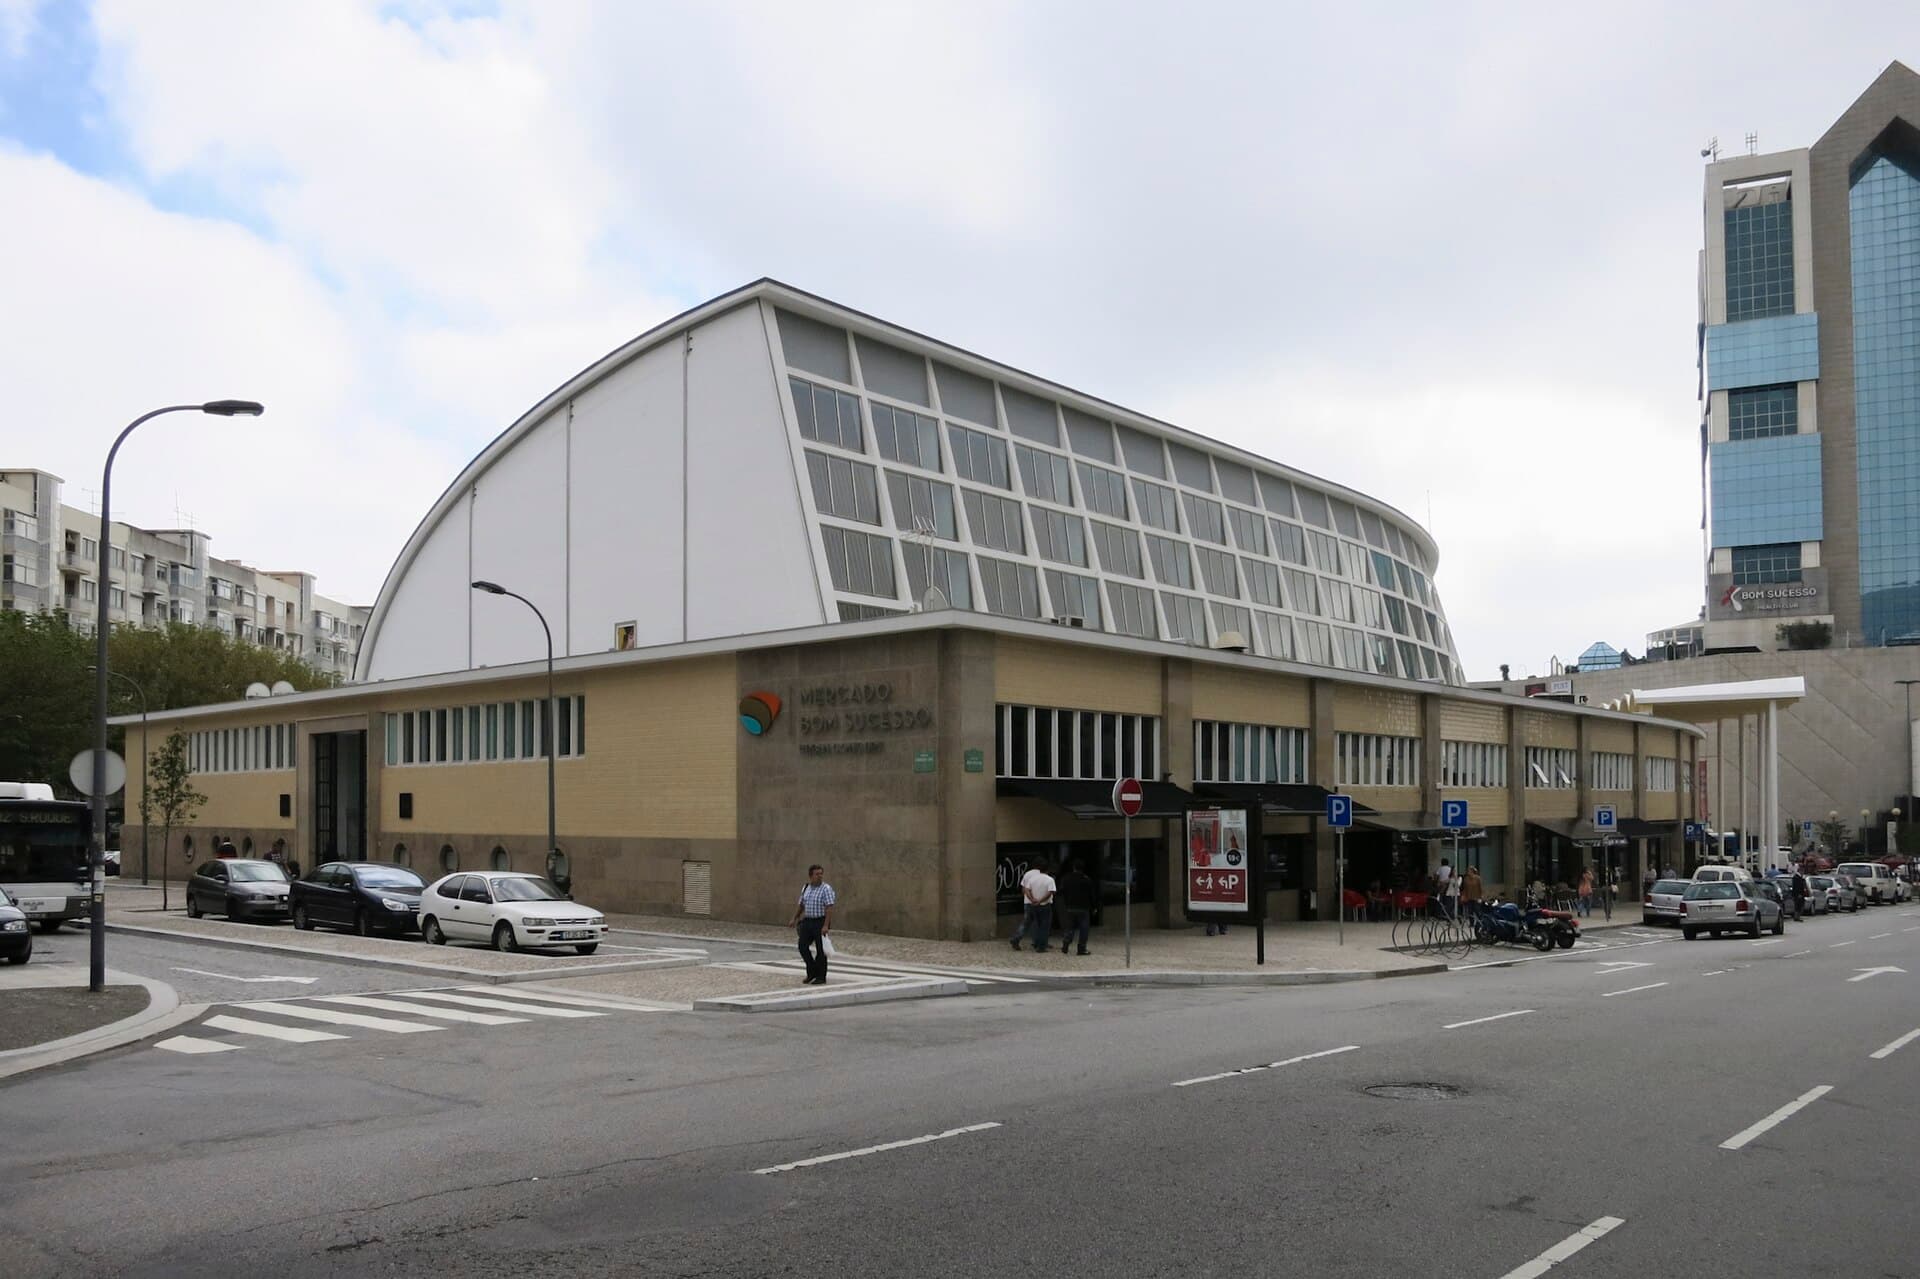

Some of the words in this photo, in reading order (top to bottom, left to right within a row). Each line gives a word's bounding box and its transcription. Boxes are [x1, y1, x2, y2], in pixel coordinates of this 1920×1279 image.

[1741, 591, 1764, 600] BOM
[1767, 587, 1817, 599] SUCESSO
[800, 683, 892, 705] MERCADO
[800, 715, 840, 733] BOM
[845, 708, 932, 732] SUCESSO
[1332, 799, 1345, 822] P
[1447, 803, 1461, 824] P
[1600, 812, 1610, 824] P
[1229, 874, 1239, 890] P
